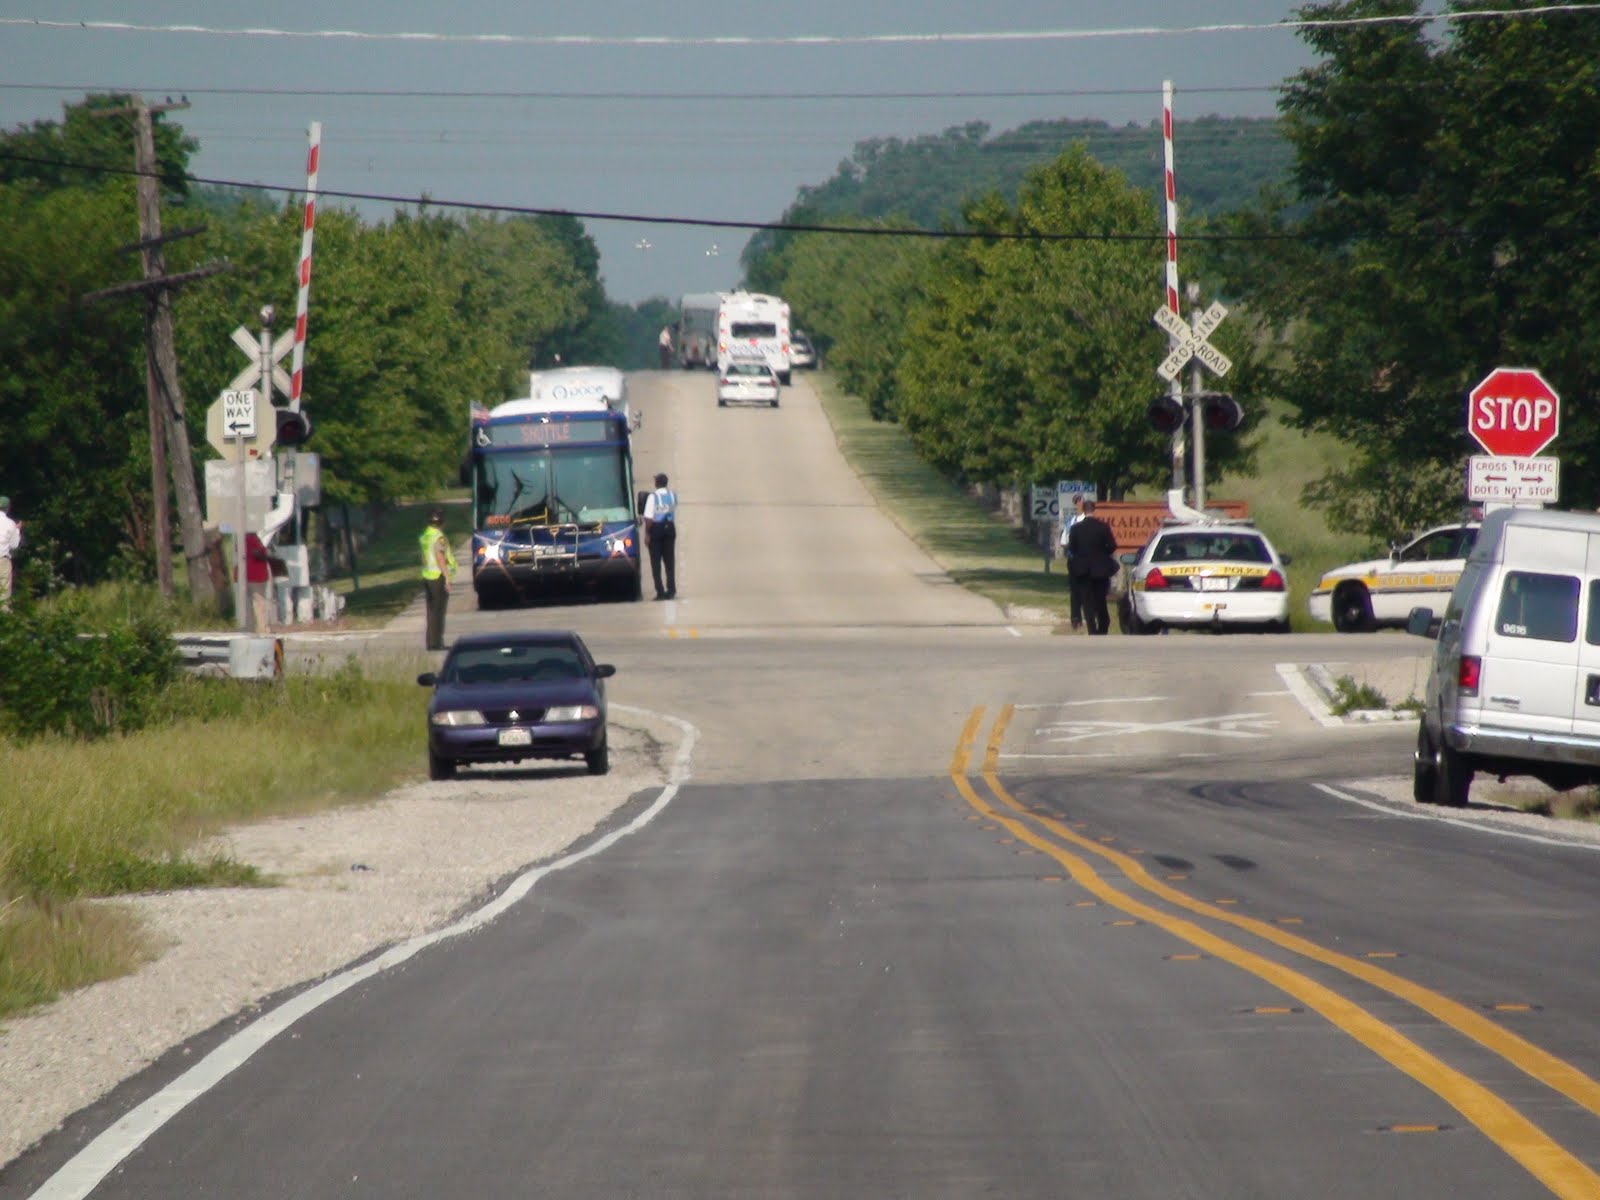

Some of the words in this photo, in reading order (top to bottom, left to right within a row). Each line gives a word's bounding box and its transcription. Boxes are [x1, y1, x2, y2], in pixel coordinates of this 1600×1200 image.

[1164, 310, 1221, 374] CROSSING
[1197, 345, 1227, 372] ROAD
[226, 393, 251, 406] ONE
[226, 407, 252, 418] WAY
[1477, 397, 1553, 432] STOP
[1475, 462, 1507, 472] CROSS
[1514, 462, 1553, 473] TRAFFIC
[1474, 485, 1499, 496] DOES
[1505, 486, 1522, 496] NOT
[1528, 487, 1553, 497] STOP
[1034, 500, 1059, 516] 20
[1224, 566, 1264, 575] POLICE
